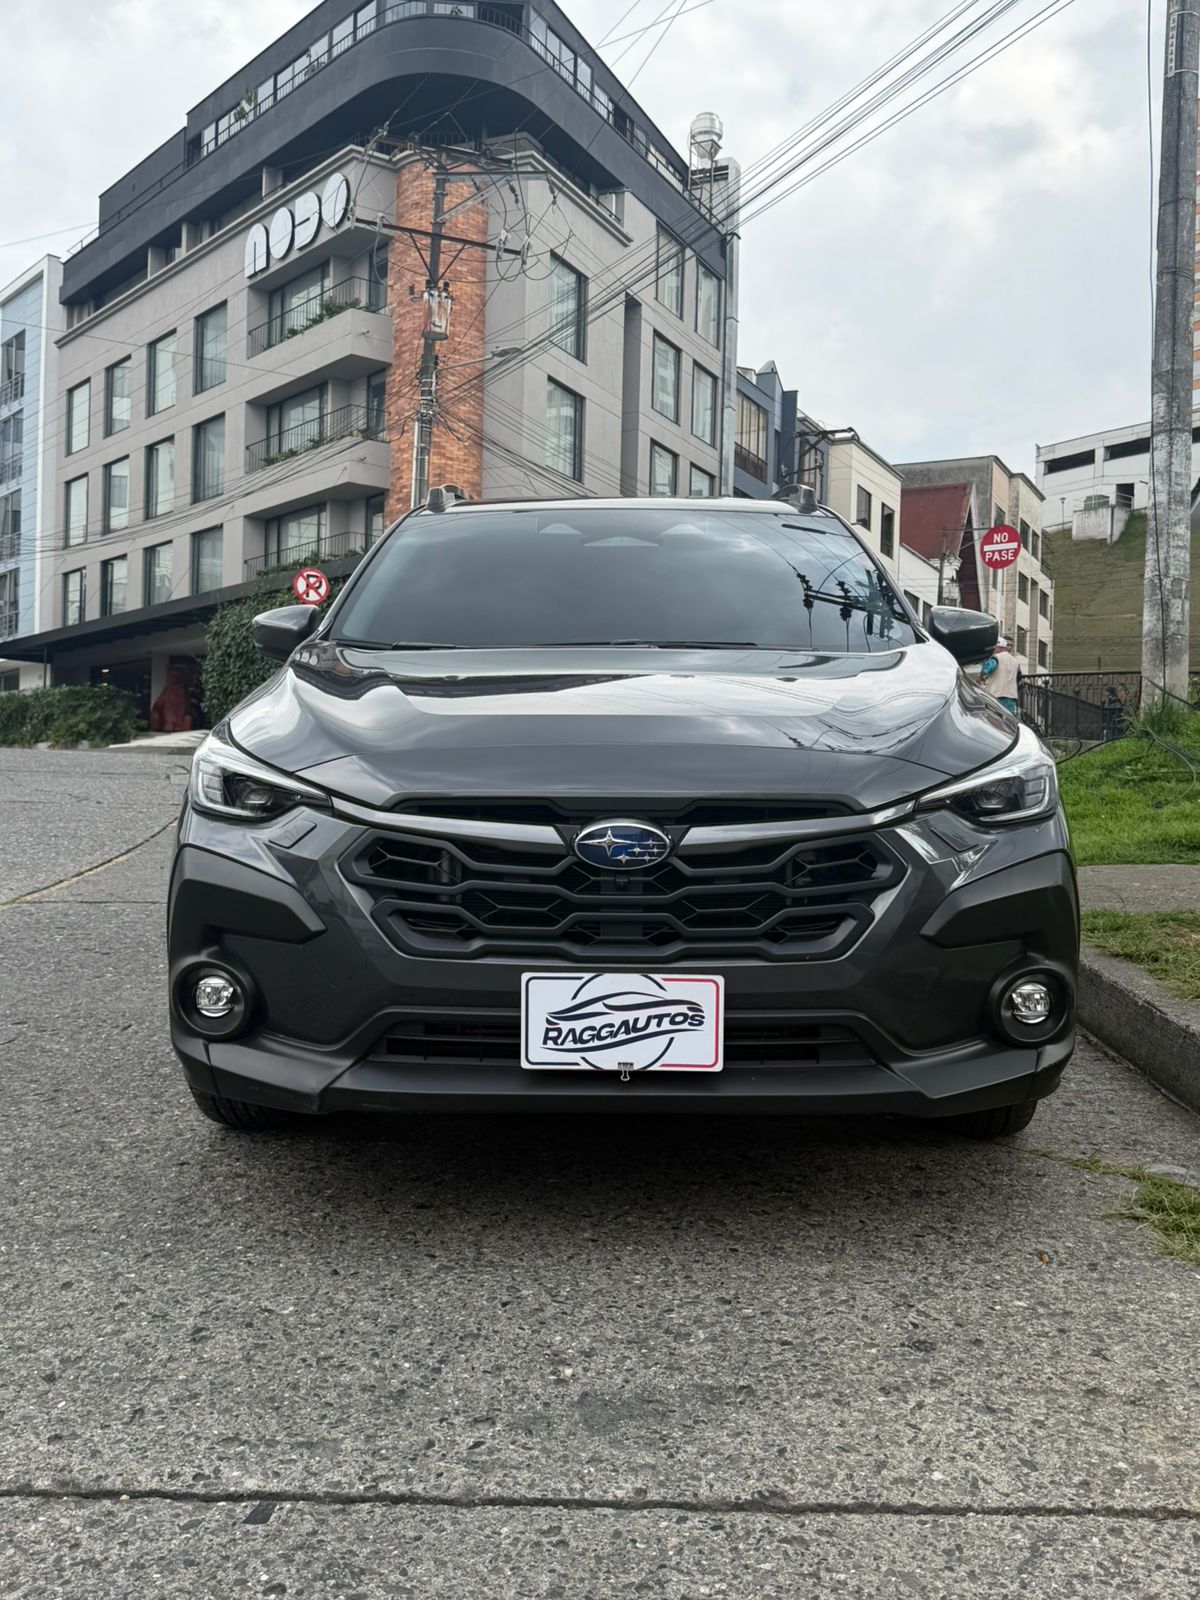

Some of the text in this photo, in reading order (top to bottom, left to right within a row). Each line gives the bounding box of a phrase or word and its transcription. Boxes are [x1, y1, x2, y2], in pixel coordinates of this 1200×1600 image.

[993, 532, 1009, 544] NO
[985, 549, 1016, 562] PASE
[542, 1012, 706, 1046] RAGGAUTOS
